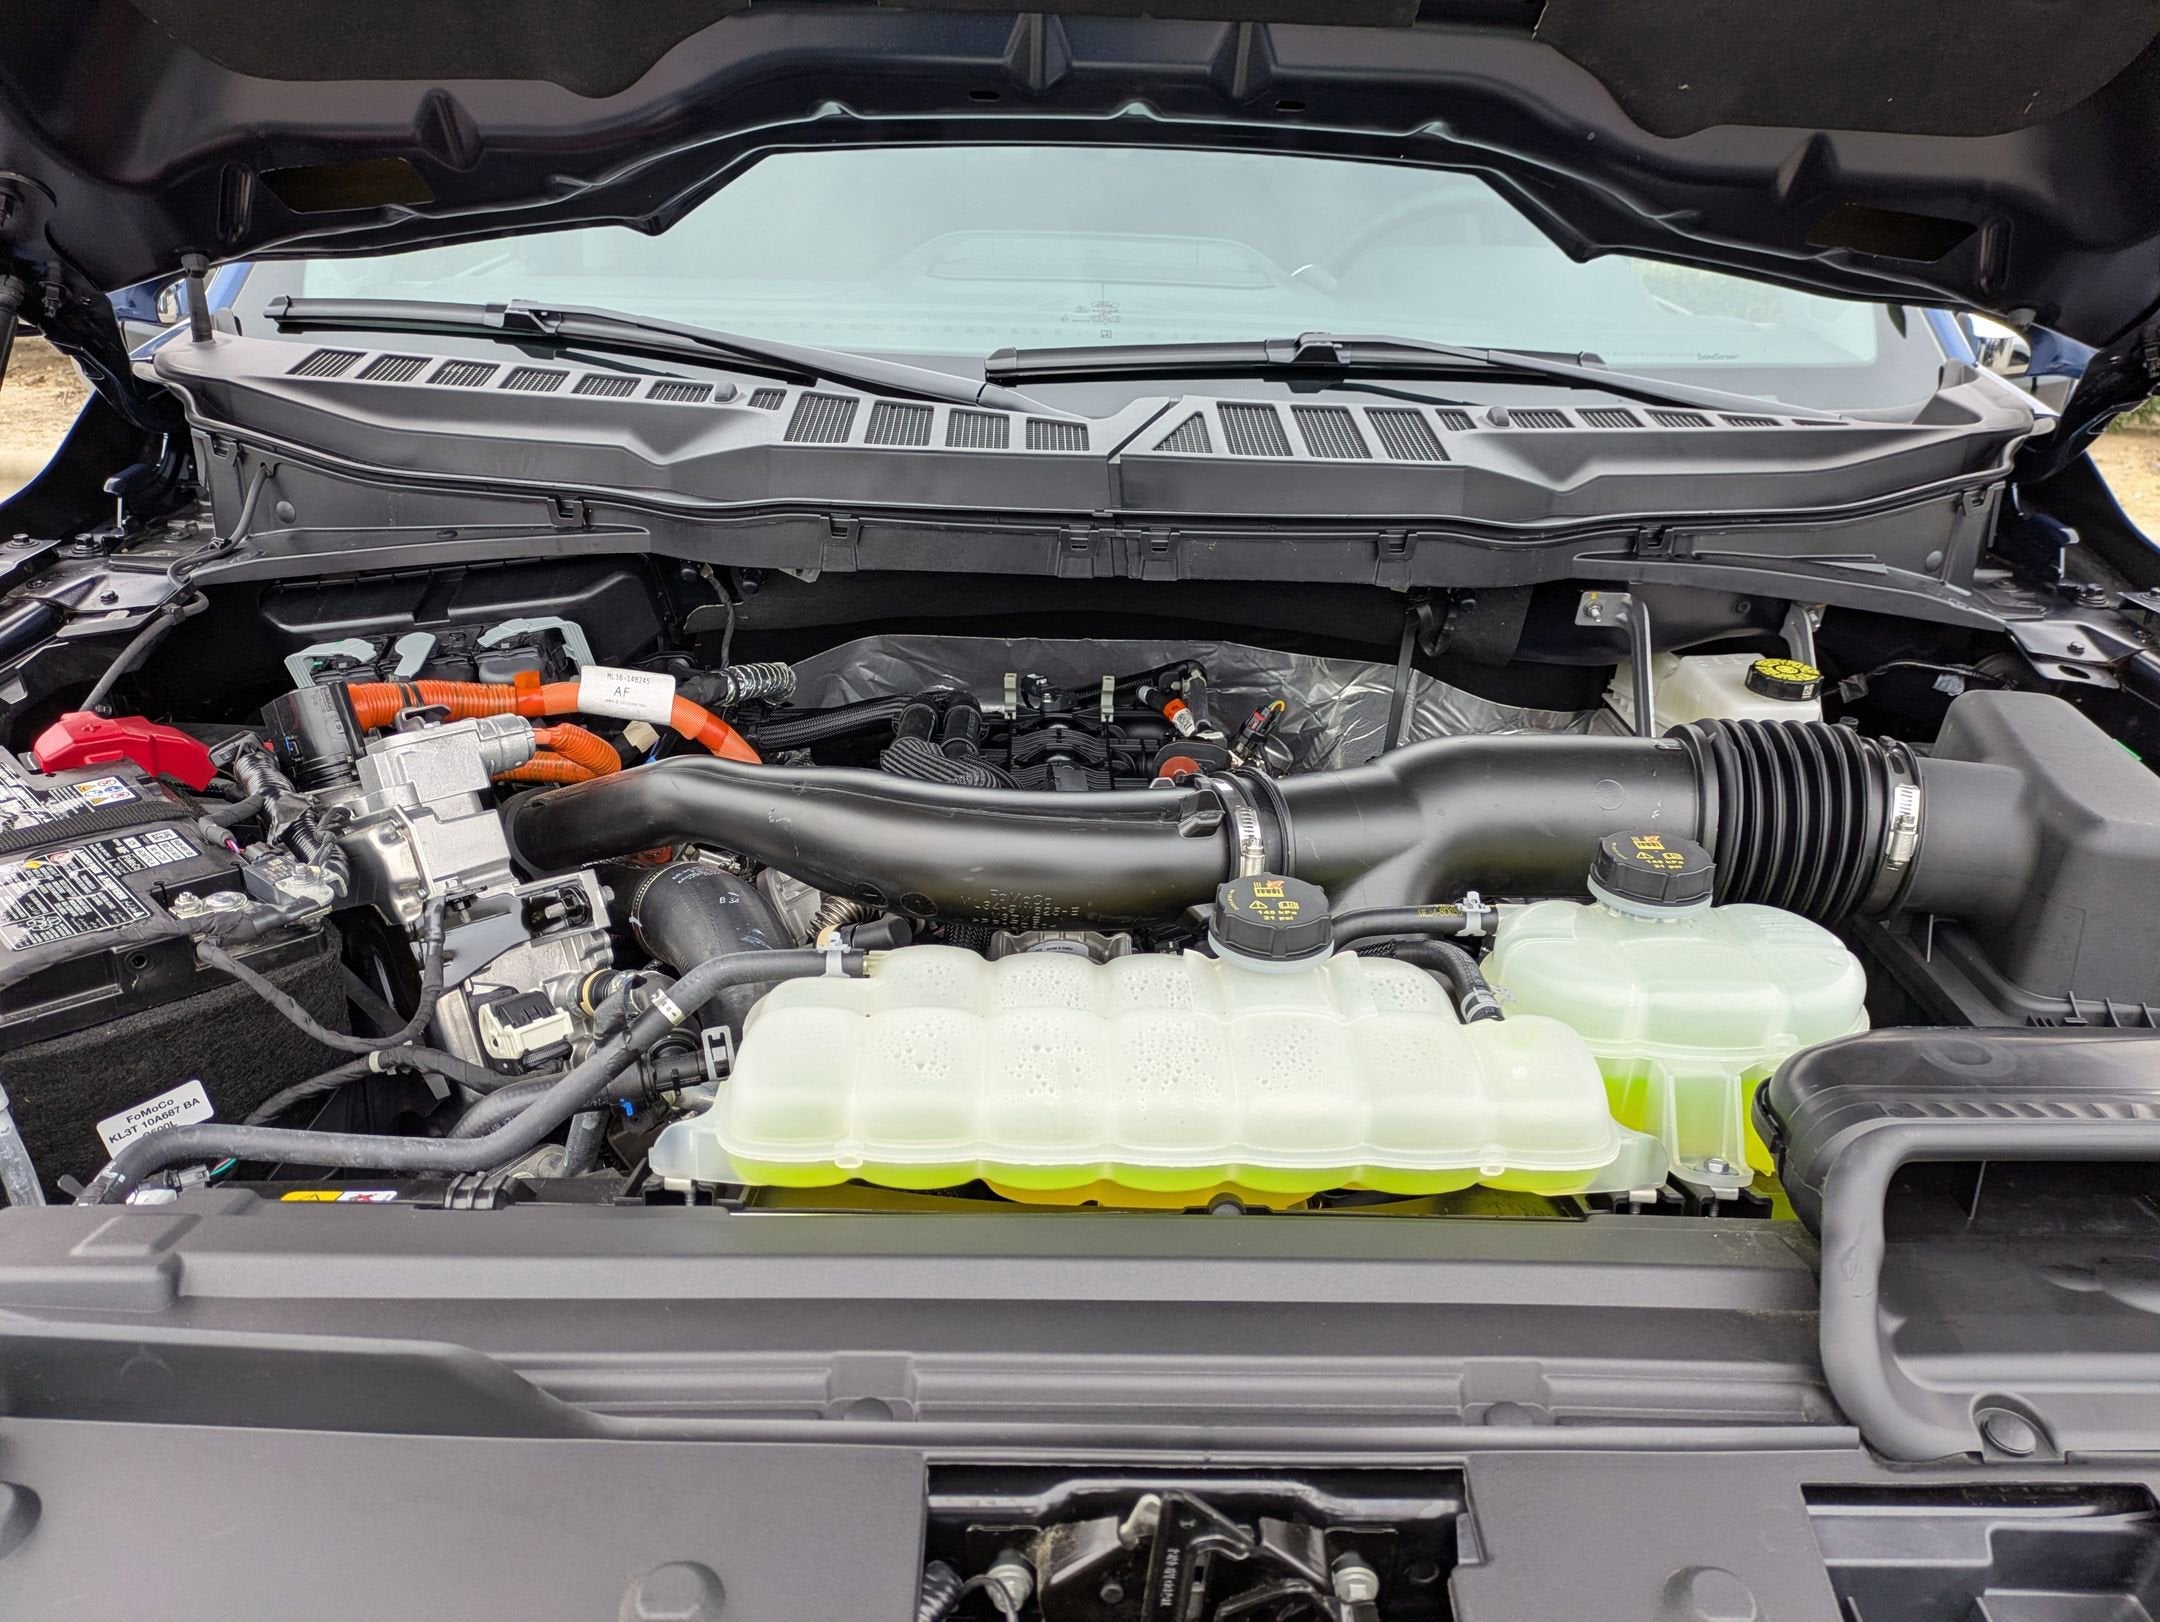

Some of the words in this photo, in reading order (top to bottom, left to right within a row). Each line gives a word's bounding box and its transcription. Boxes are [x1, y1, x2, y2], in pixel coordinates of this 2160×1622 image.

[613, 686, 631, 697] AF
[108, 1125, 138, 1144] KL3T
[141, 1106, 180, 1129] 10A687
[183, 1097, 201, 1110] BA
[126, 1099, 174, 1124] FoMoCo
